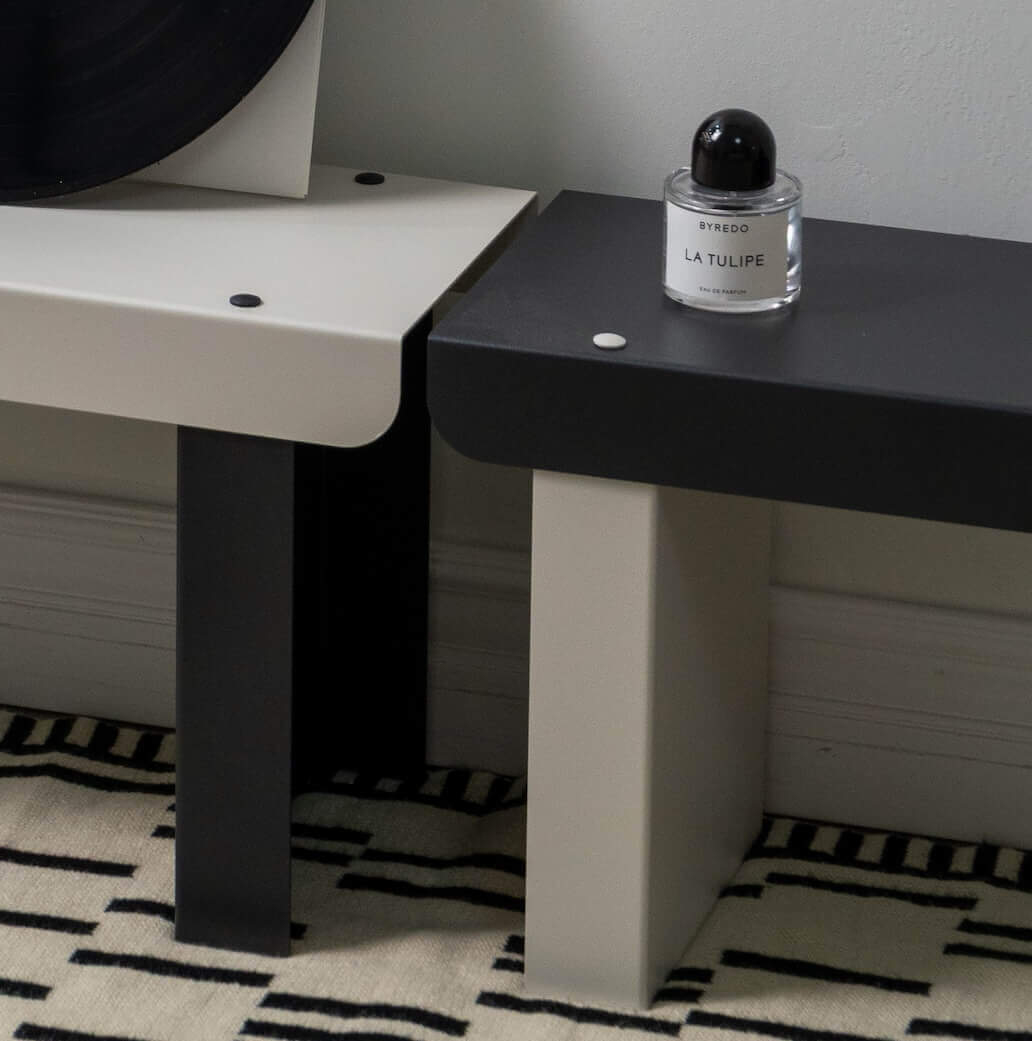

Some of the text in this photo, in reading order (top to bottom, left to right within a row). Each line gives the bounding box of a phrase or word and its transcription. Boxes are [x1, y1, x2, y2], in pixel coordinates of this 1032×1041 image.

[699, 221, 750, 233] BYREDO
[685, 247, 765, 267] LA TULIPE
